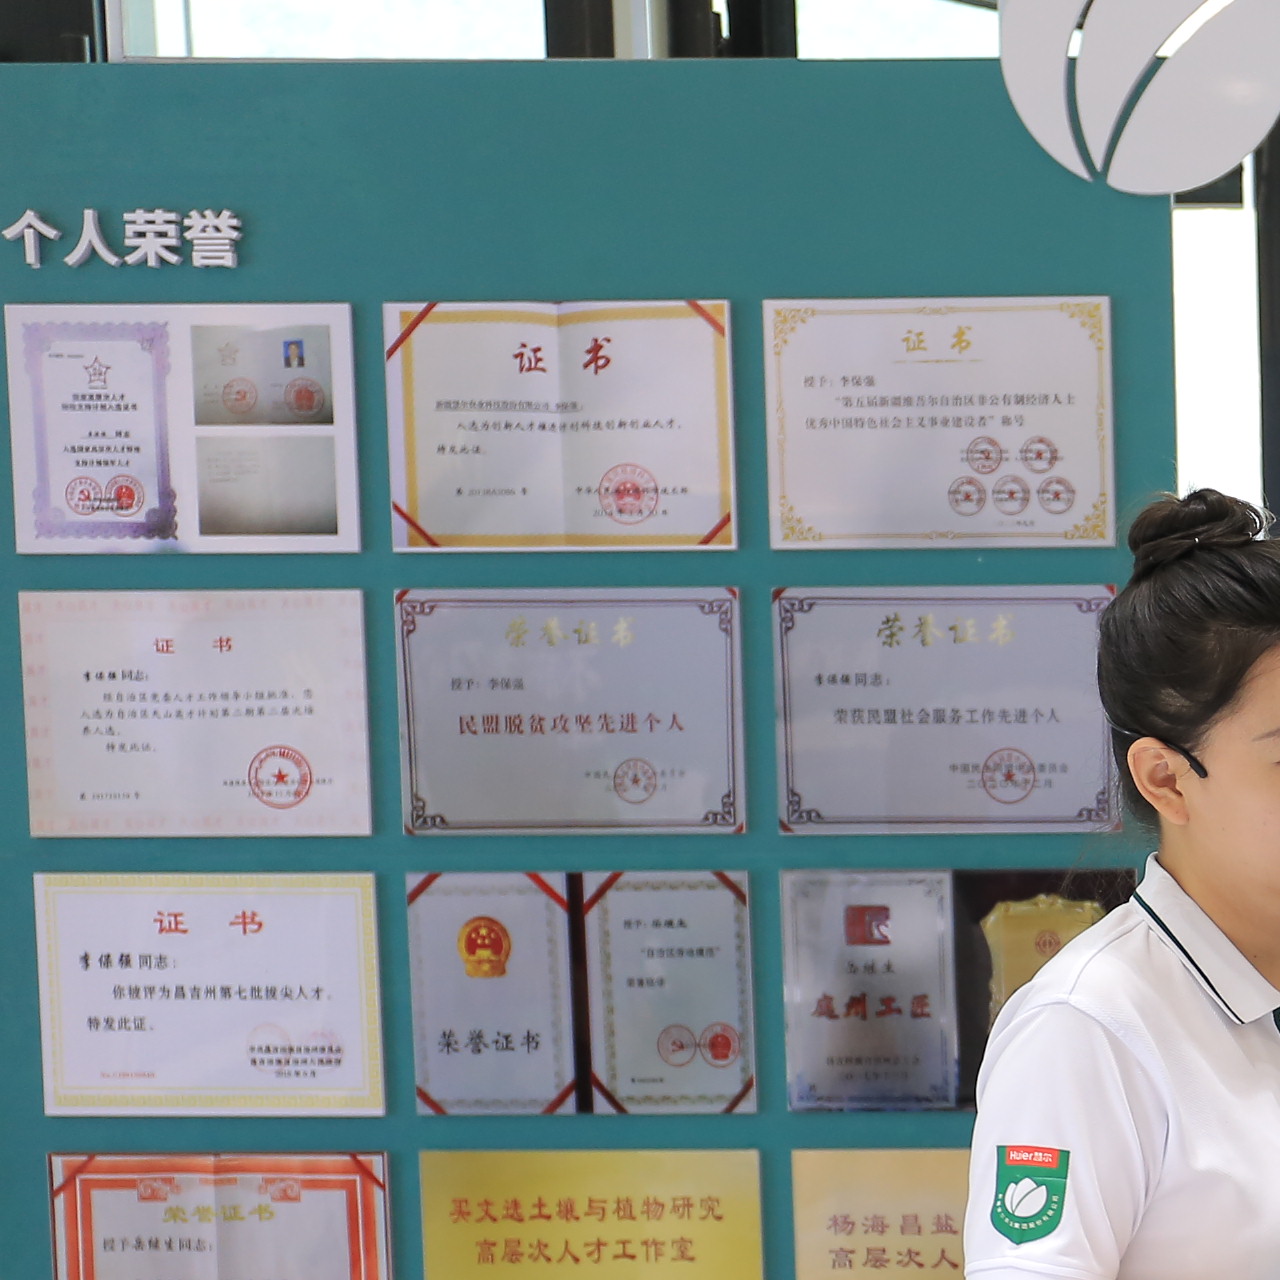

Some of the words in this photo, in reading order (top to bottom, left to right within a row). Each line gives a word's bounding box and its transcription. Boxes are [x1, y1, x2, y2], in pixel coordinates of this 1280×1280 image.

[2, 208, 242, 268] 个人荣誉
[901, 325, 973, 354] 证书
[512, 337, 612, 375] 证书
[505, 615, 637, 648] 荣誉证书
[876, 612, 1016, 648] 荣誉证书
[153, 636, 233, 655] 证书
[458, 711, 685, 737] 民盟脱贫攻坚先进个人
[833, 707, 1061, 726] 荣获民盟社会服务工作先进个人
[153, 909, 264, 936] 证书
[79, 951, 177, 971] 李保强同志：
[437, 1029, 542, 1055] 荣誉证书
[162, 1203, 275, 1224] 荣誉证书
[449, 1196, 724, 1224] 买文选土壤与植物研究
[827, 1213, 959, 1237] 杨海昌盐
[475, 1236, 697, 1265] 高层次人才工作室
[829, 1247, 960, 1270] 高层次人
